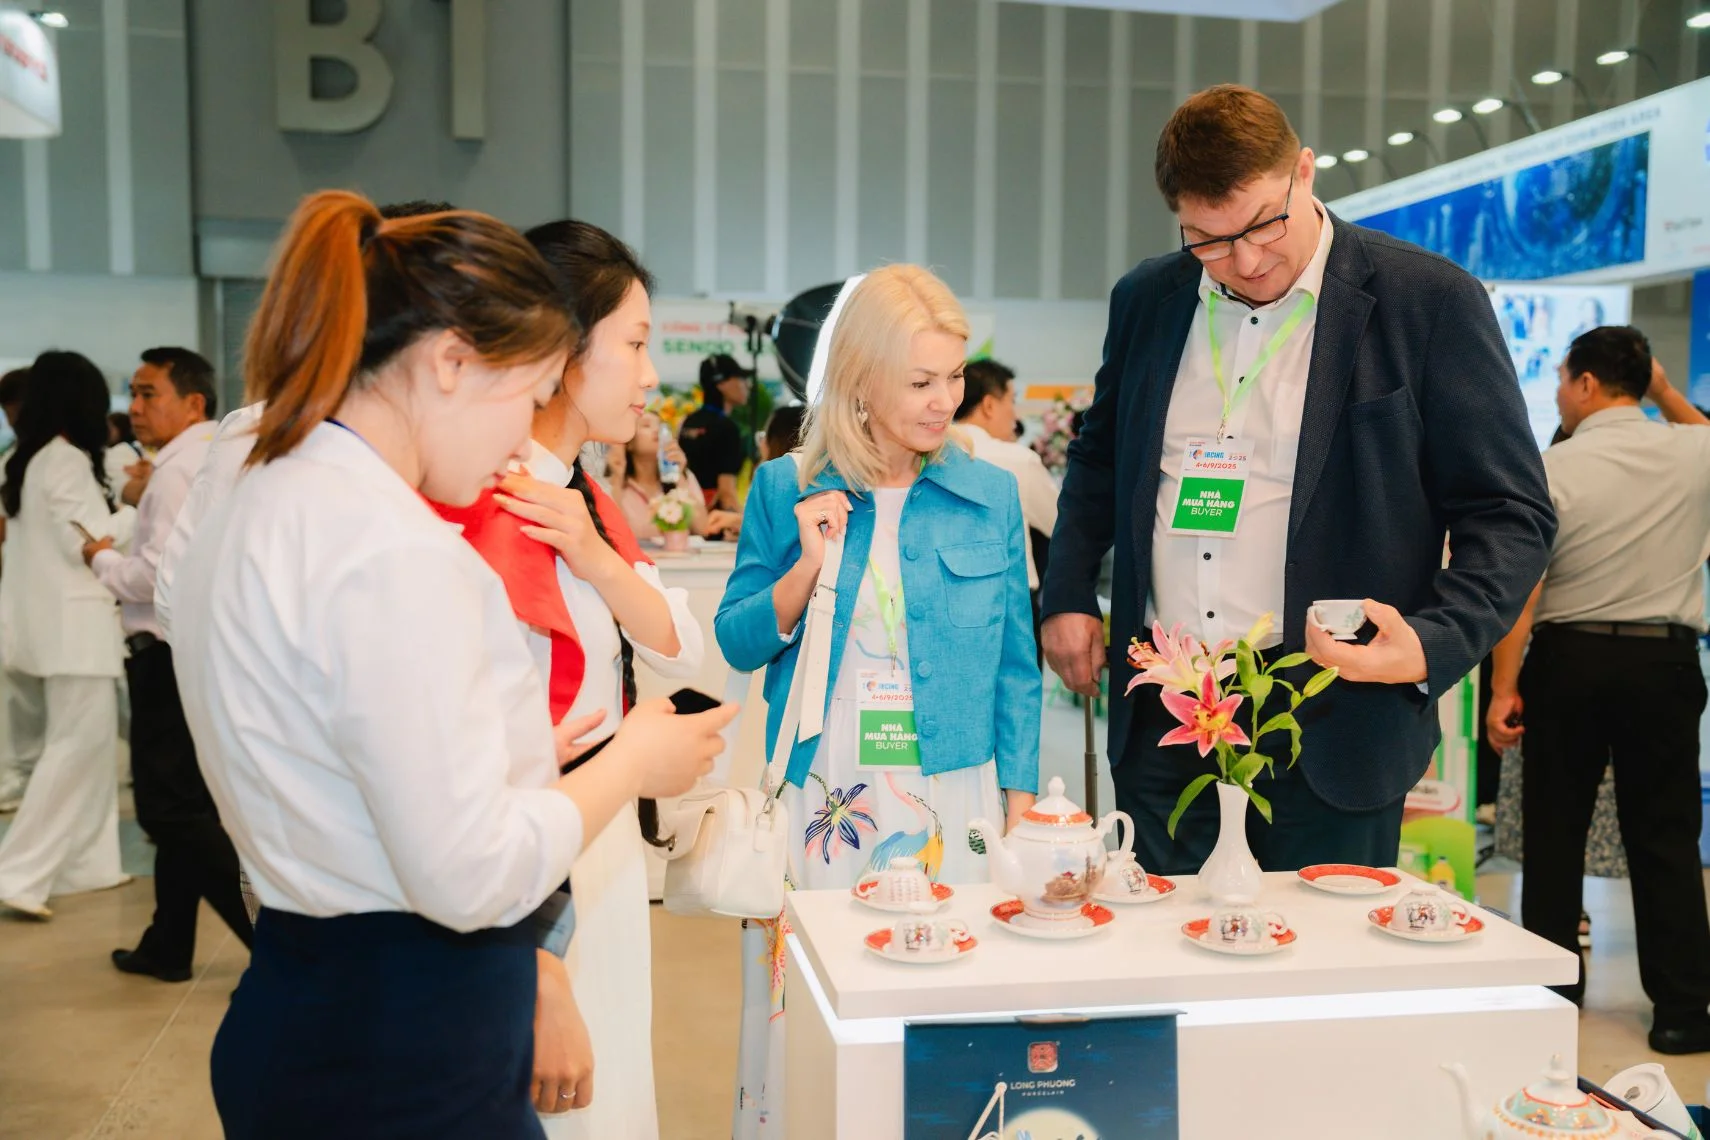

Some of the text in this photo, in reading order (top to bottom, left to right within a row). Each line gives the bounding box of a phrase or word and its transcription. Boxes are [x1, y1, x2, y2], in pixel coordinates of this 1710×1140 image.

[1199, 489, 1221, 499] NHÀ
[1182, 498, 1235, 509] MUA HÀNG
[1191, 507, 1222, 516] BUYER
[864, 732, 887, 740] MUA
[875, 742, 908, 750] BUYER
[1010, 1081, 1035, 1089] LONG
